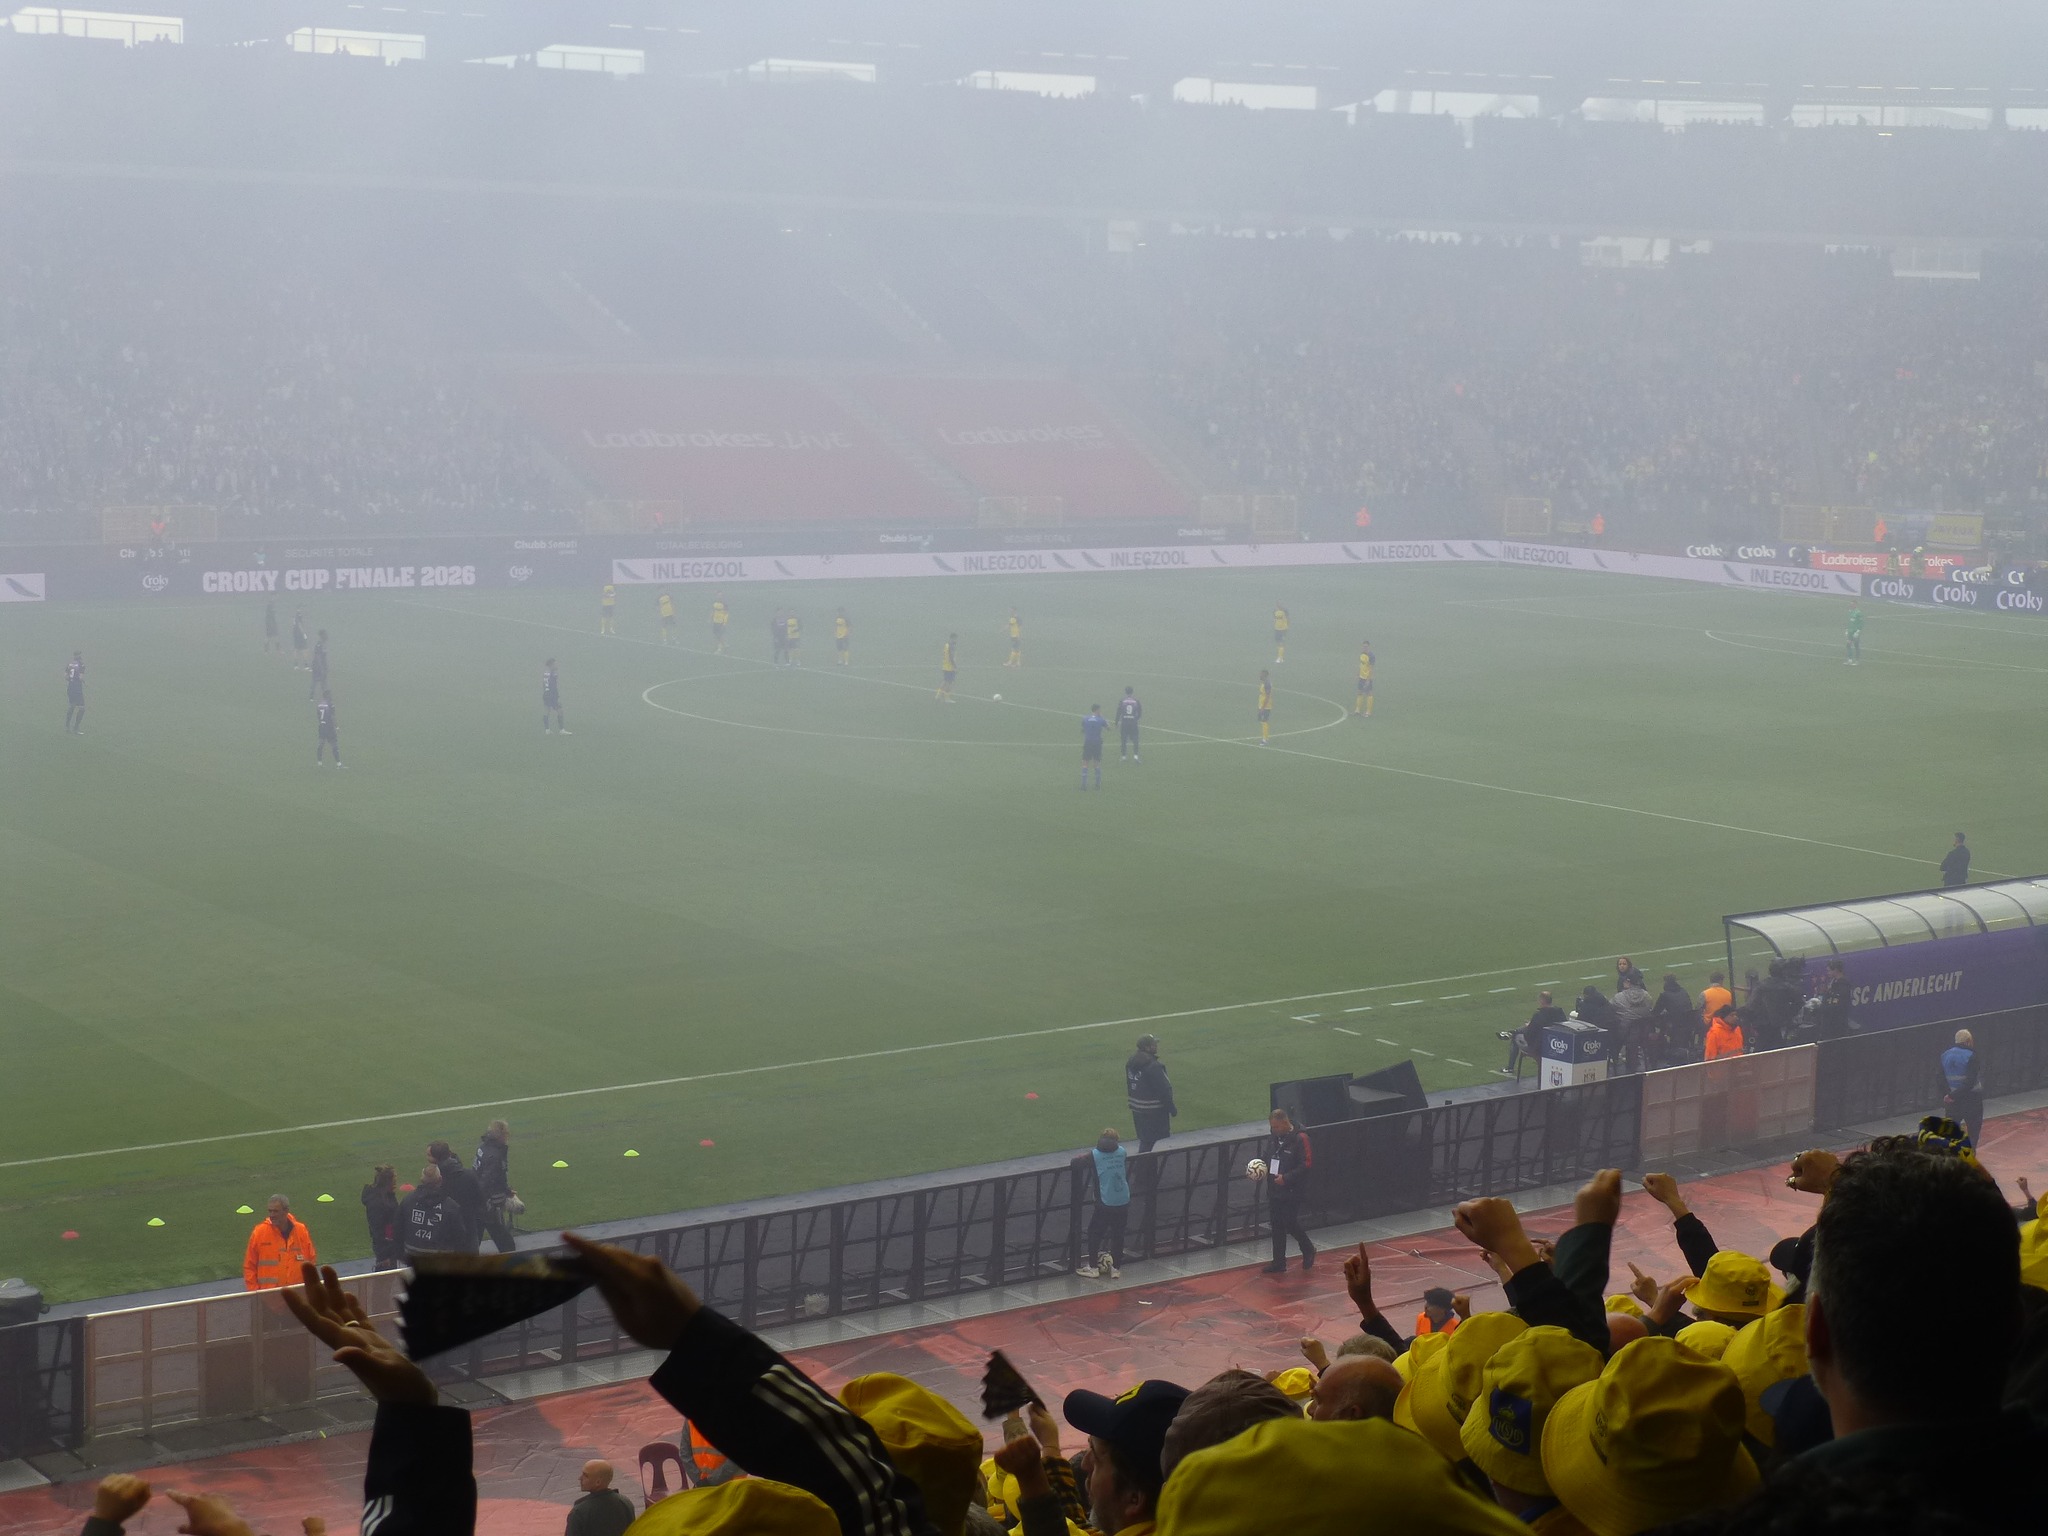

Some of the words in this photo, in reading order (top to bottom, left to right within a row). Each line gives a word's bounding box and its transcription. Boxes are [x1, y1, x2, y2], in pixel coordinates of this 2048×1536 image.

[583, 428, 774, 449] Ladbrokes
[936, 423, 1103, 445] Ladbrokes
[514, 540, 546, 550] Chubb
[1367, 544, 1438, 560] INLEGZOOL
[1503, 545, 1572, 566] INLEGZOOL
[963, 554, 1047, 572] INLEGZOOL
[1110, 550, 1189, 567] INLEGZOOL
[1822, 553, 1878, 566] Ladbrokes
[202, 570, 279, 593] CROKY
[285, 569, 330, 591] CUP
[335, 566, 415, 589] FINALE
[420, 565, 476, 587] 2026
[652, 561, 748, 580] INLEGZOOL
[1750, 567, 1829, 590] INLEGZOOL
[1870, 578, 1914, 599] Croky
[1932, 584, 1977, 605] Croky
[1996, 590, 2043, 612] Croky
[1850, 985, 1870, 1007] SC
[1873, 970, 1963, 1003] ANDERLECHT
[1550, 1038, 1569, 1051] Croky
[415, 1229, 432, 1240] 474
